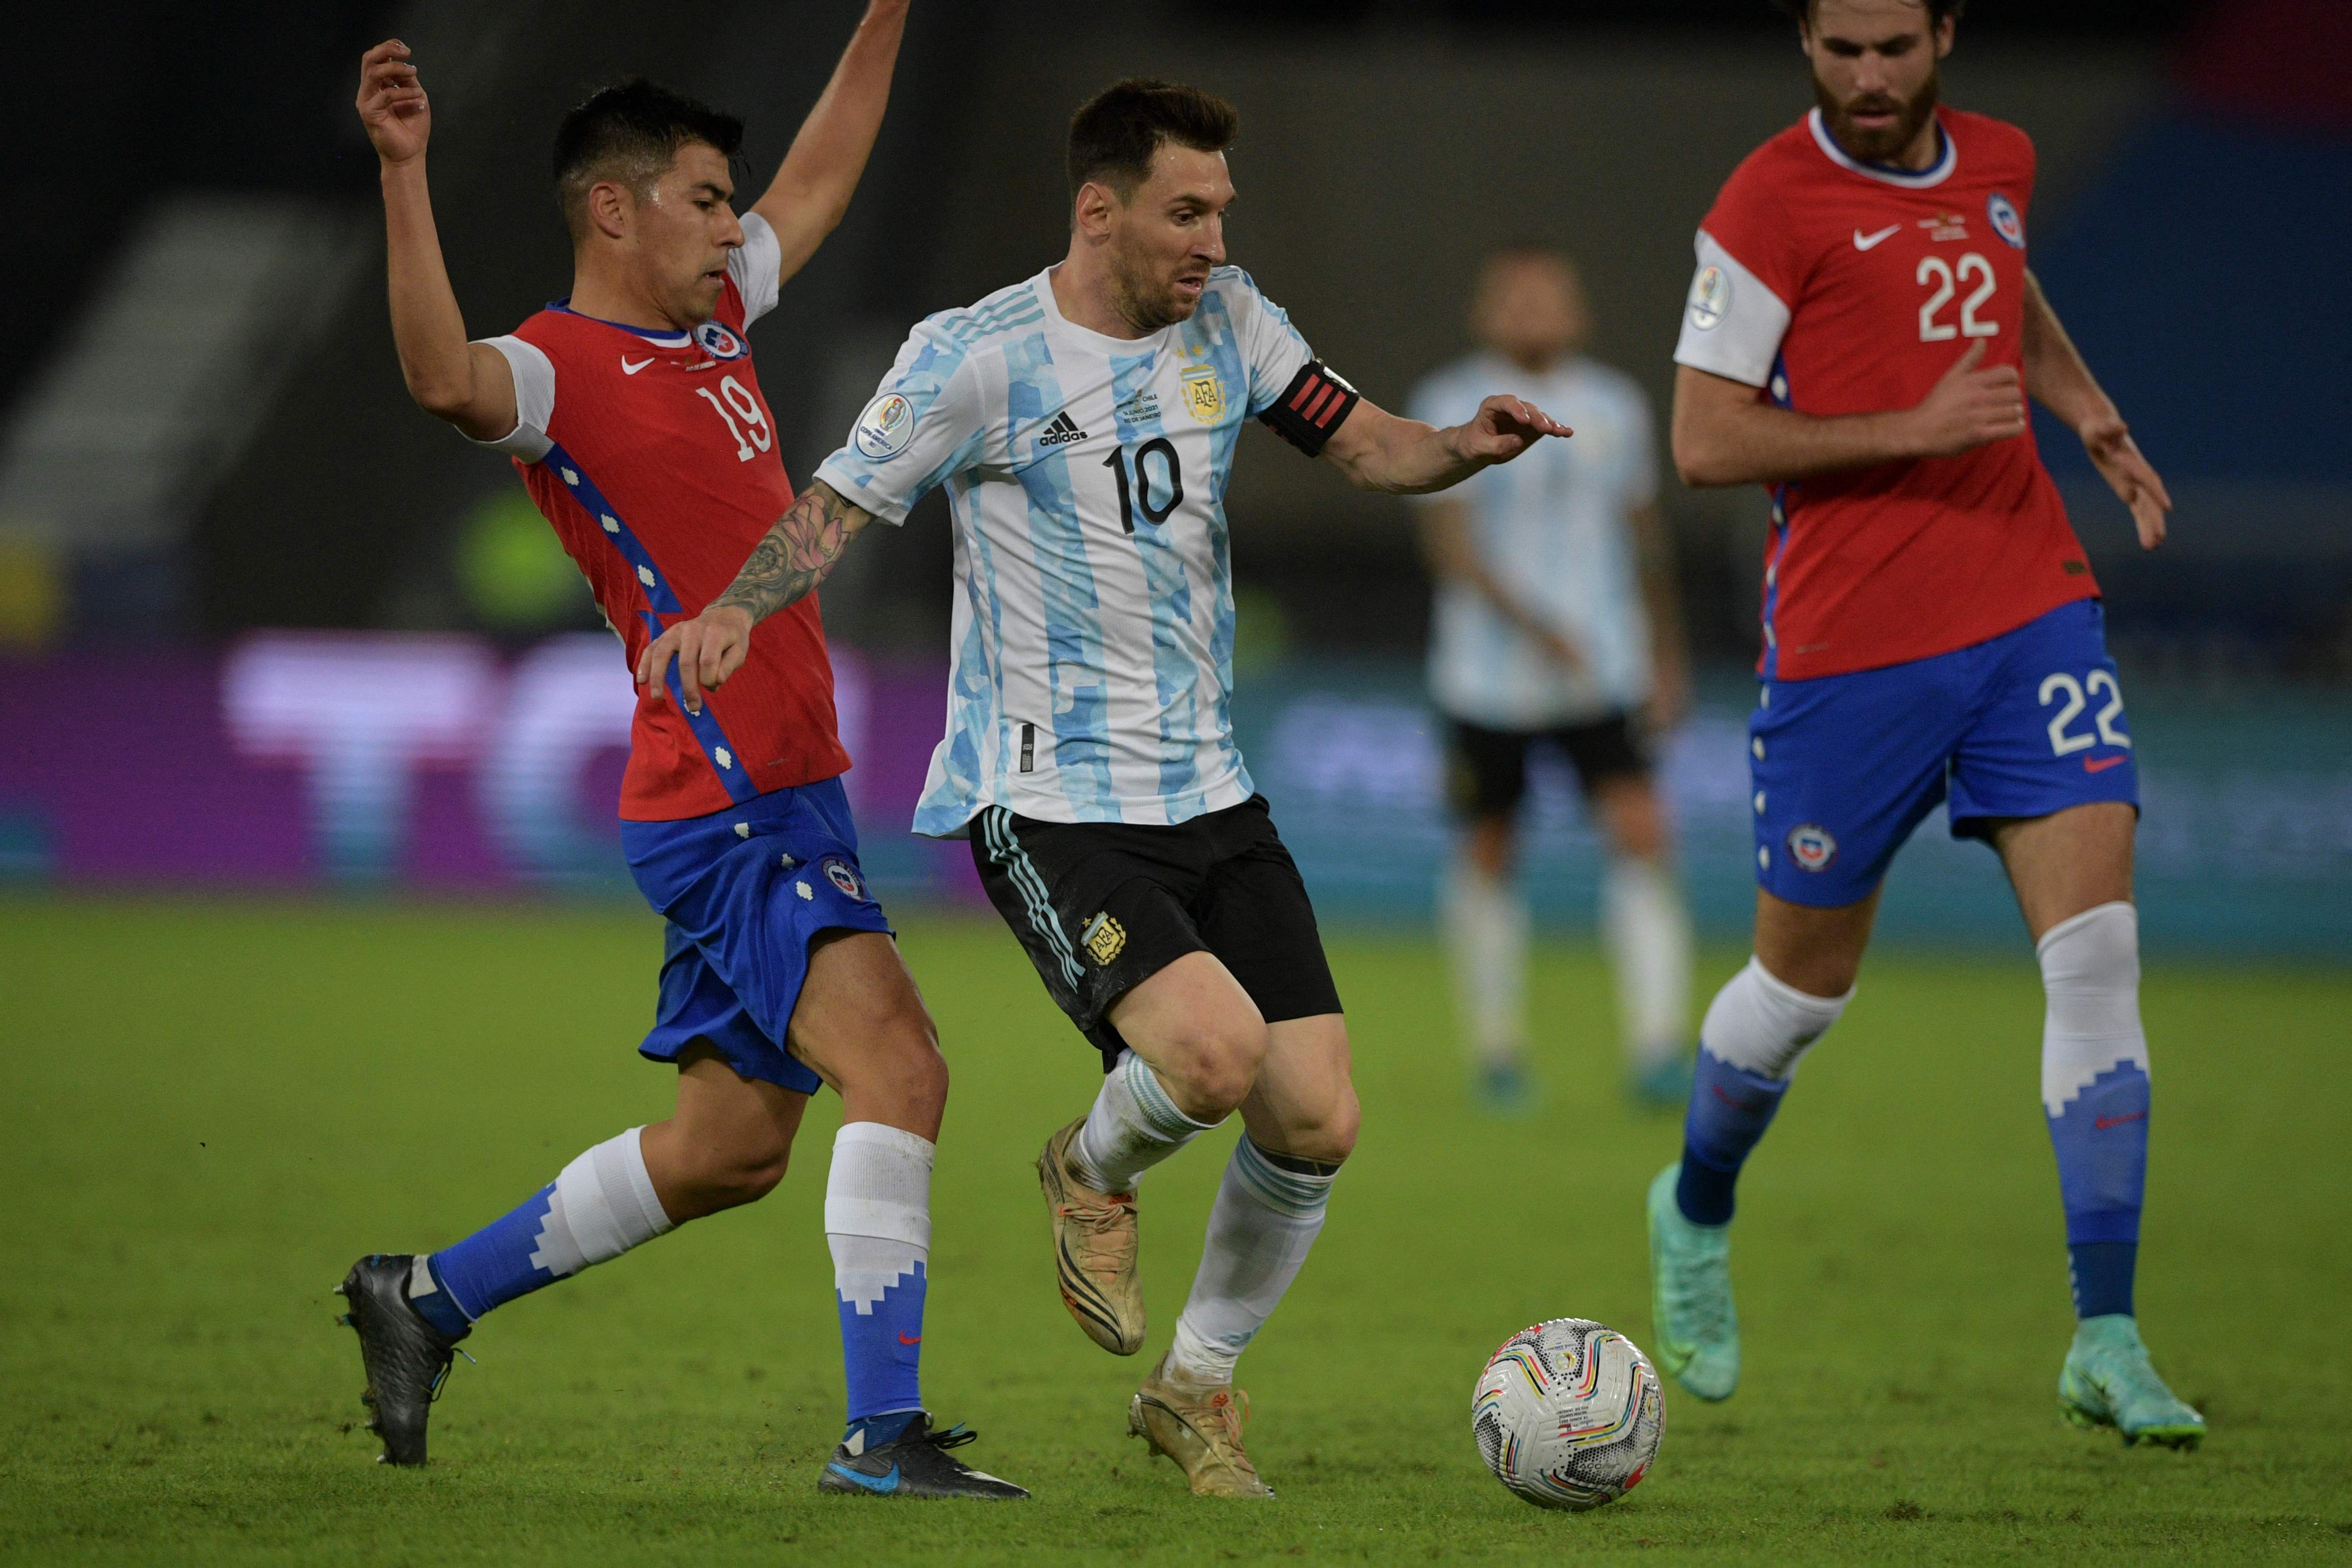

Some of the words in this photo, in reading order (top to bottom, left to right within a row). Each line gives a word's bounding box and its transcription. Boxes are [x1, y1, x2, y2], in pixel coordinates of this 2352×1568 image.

[1916, 252, 1999, 342] 22
[1195, 381, 1217, 407] AFA
[695, 375, 771, 462] 19
[1140, 412, 1161, 421] JANEIRO
[860, 427, 872, 436] COPA
[1039, 430, 1088, 446] adidas
[1102, 437, 1184, 534] 10
[2038, 669, 2132, 757] 22
[1093, 926, 1114, 953] AFA
